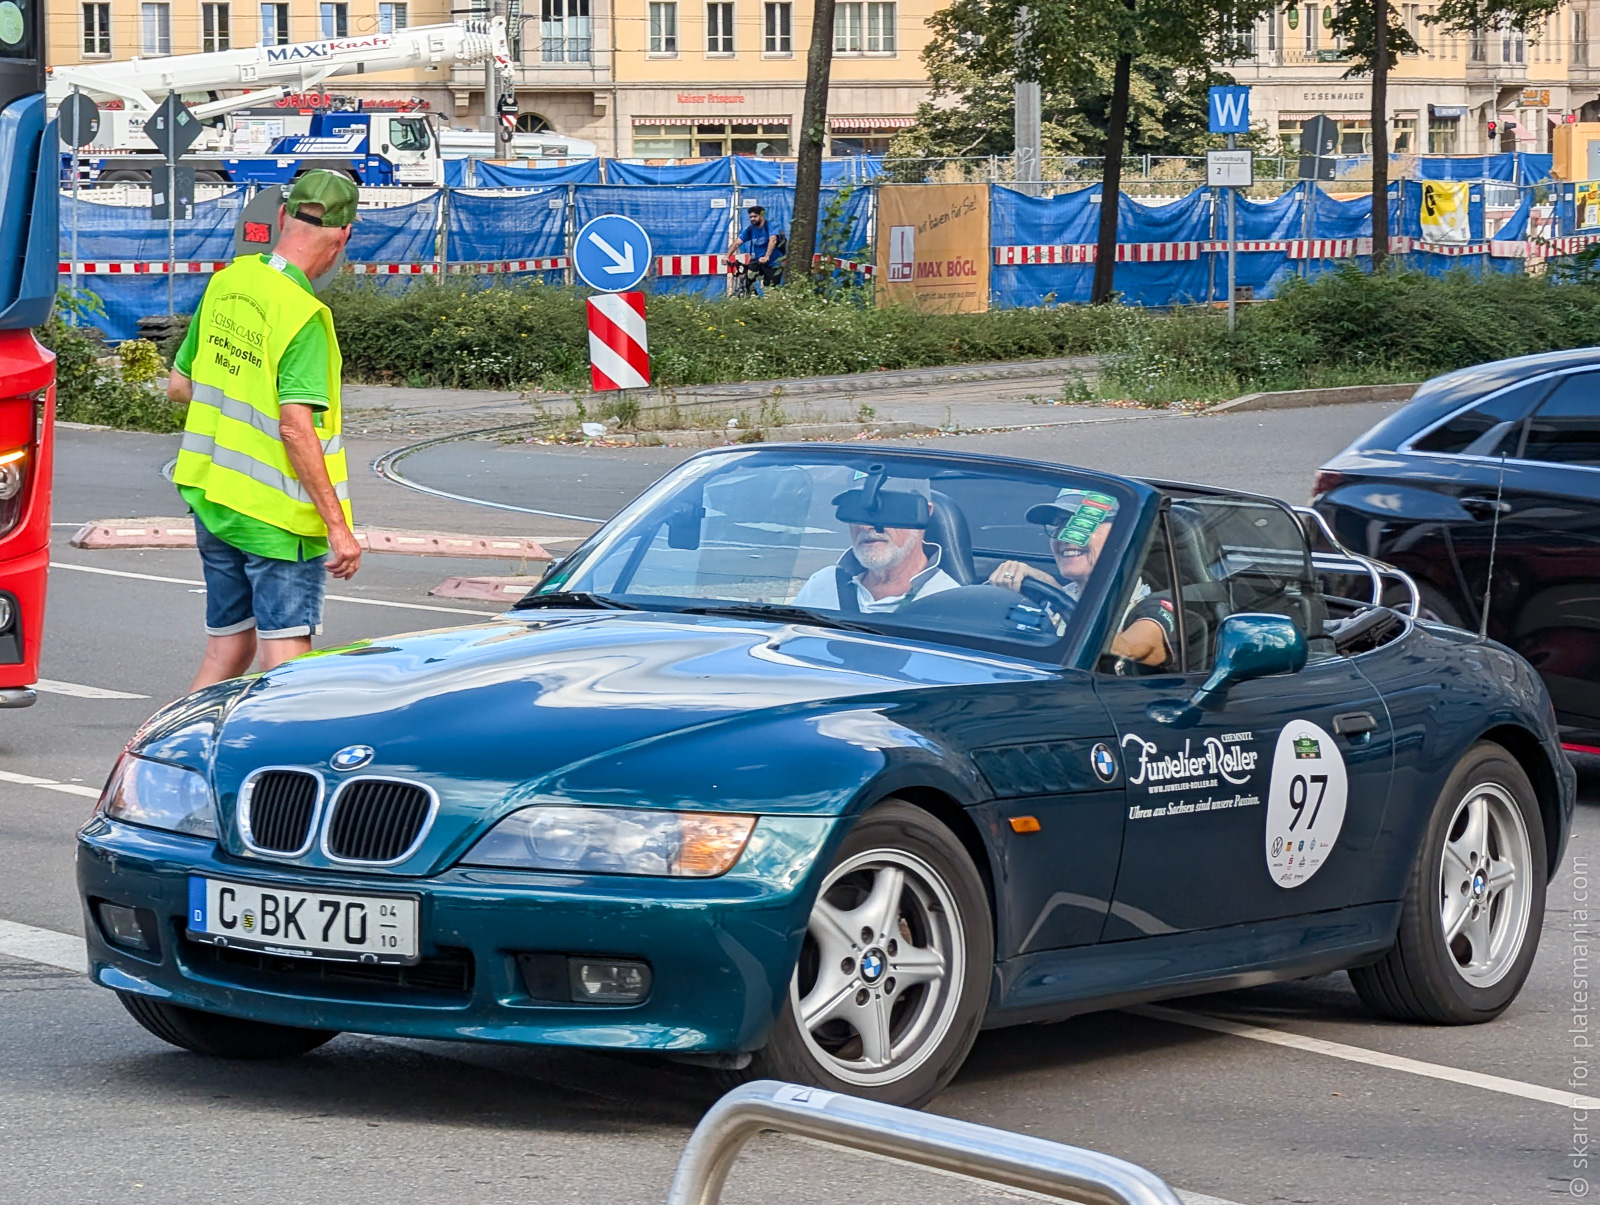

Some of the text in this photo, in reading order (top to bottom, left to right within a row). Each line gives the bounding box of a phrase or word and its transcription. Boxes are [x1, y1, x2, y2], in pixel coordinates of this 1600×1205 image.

[677, 93, 745, 103] Kaiser Friseure
[1213, 93, 1246, 127] W
[917, 256, 977, 278] MAX BÖGL
[1221, 732, 1253, 742] CHEMNITZ
[1203, 737, 1258, 784] Roller
[1148, 779, 1218, 794] WWW.JUWELIER-ROLLER.DE
[1129, 794, 1260, 820] Uhren aus Sachsen sind unsere Passion.
[1289, 774, 1328, 832] 97
[194, 909, 202, 922] D
[219, 887, 367, 945] C BK 70
[380, 905, 397, 917] 04
[381, 935, 398, 948] 10
